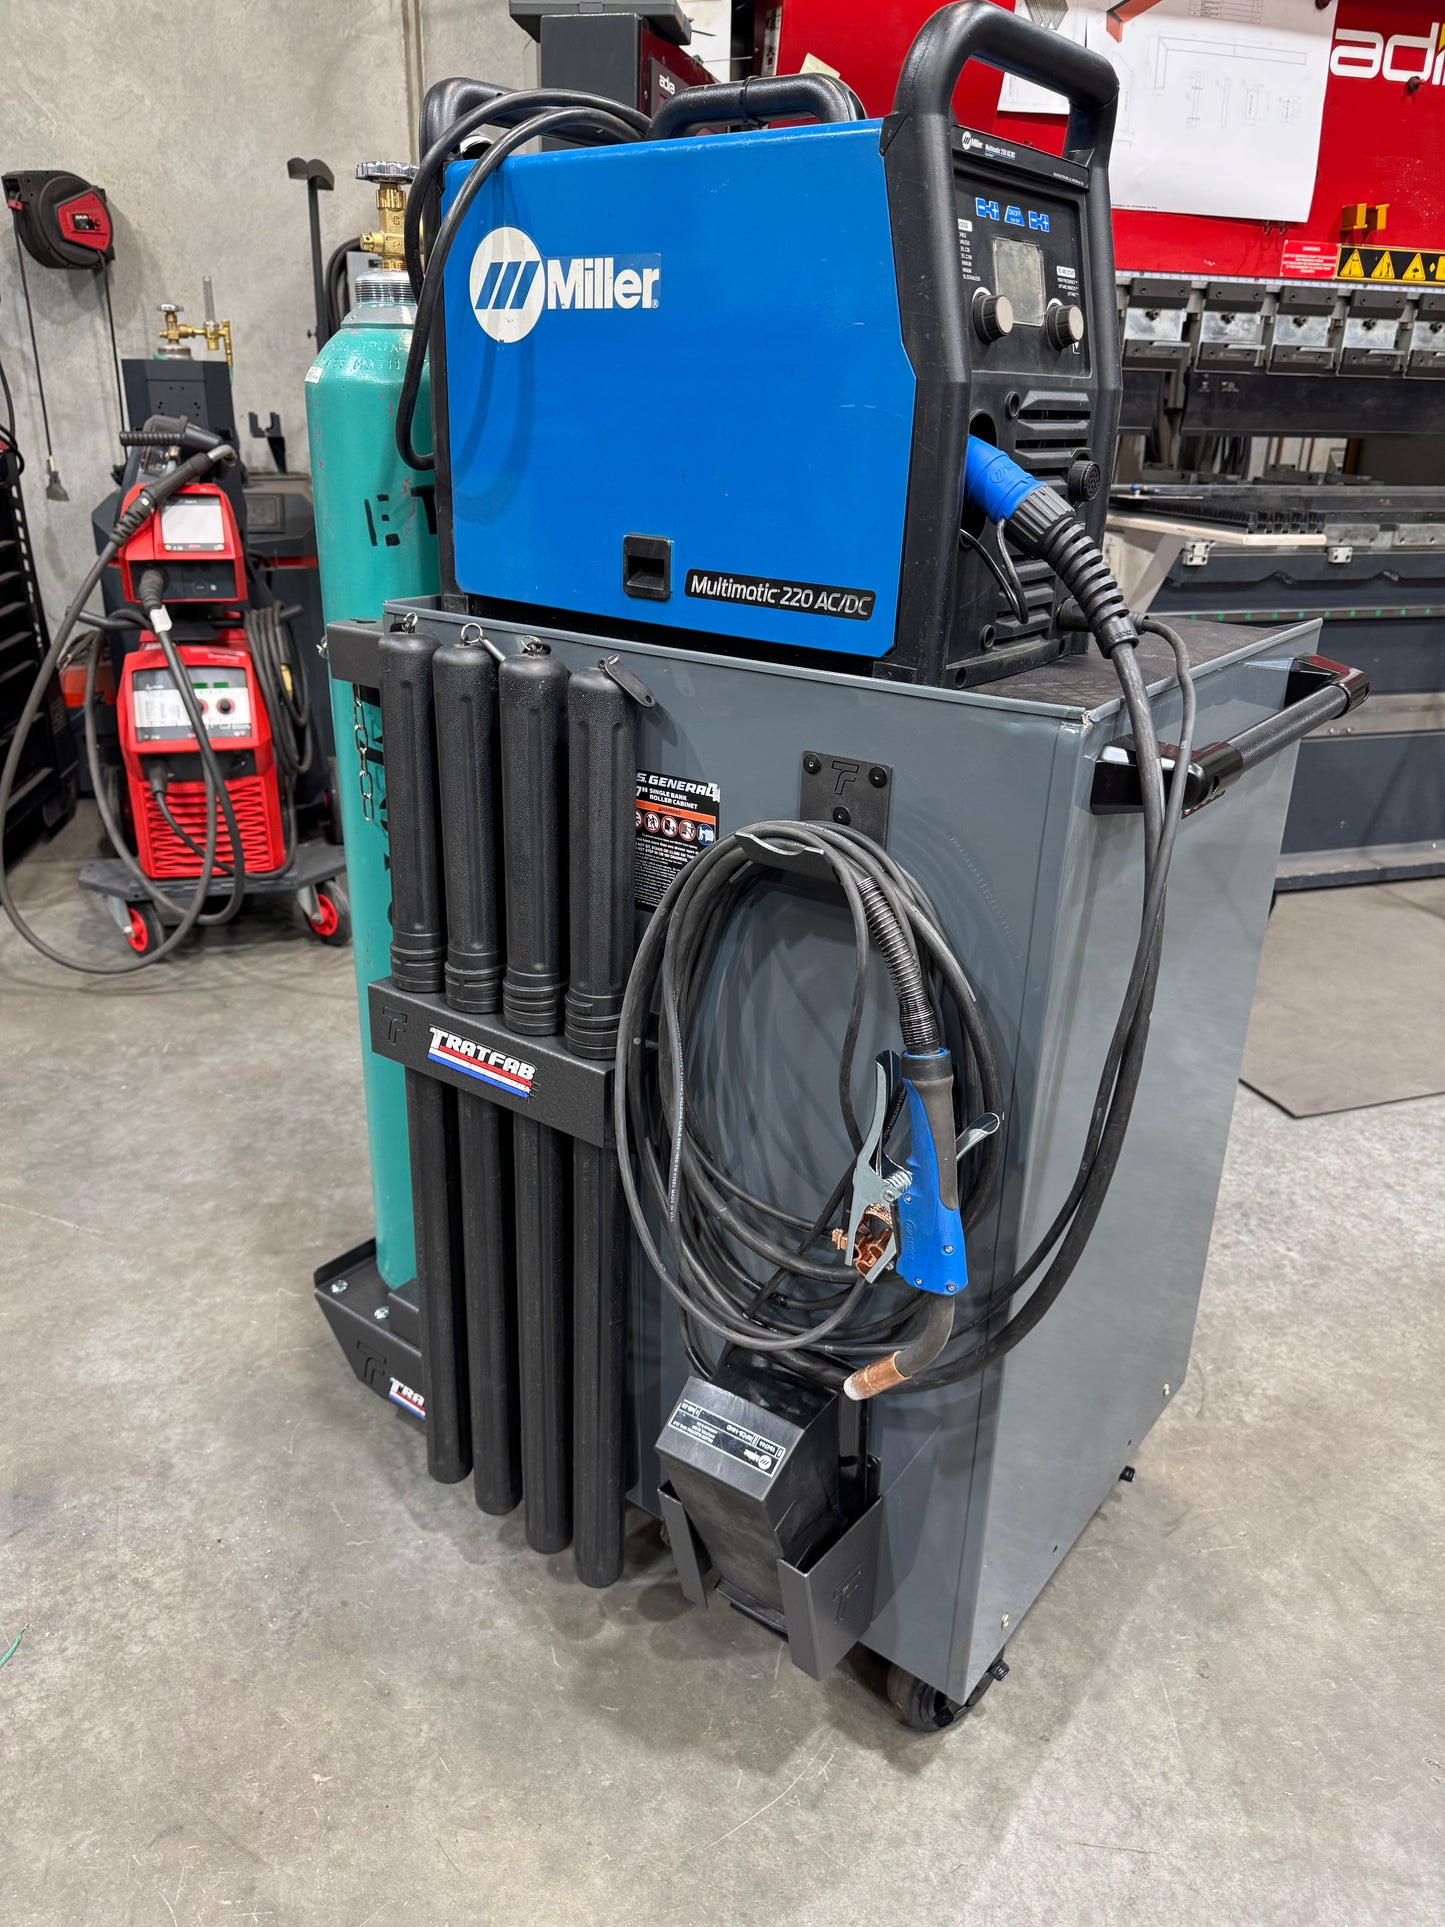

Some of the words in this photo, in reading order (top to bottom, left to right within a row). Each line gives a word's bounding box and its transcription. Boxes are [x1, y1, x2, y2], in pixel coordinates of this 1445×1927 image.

[691, 575, 780, 604] Multimatic
[780, 586, 813, 608] 220
[814, 591, 872, 616] AC/DC
[648, 775, 716, 798] GENERAL
[650, 788, 670, 798] SINGLE
[671, 792, 688, 801] BANK
[650, 794, 673, 805] ROLLER
[673, 799, 698, 810] CABINET
[429, 1027, 536, 1080] TRATFAB
[390, 1376, 425, 1407] TRA
